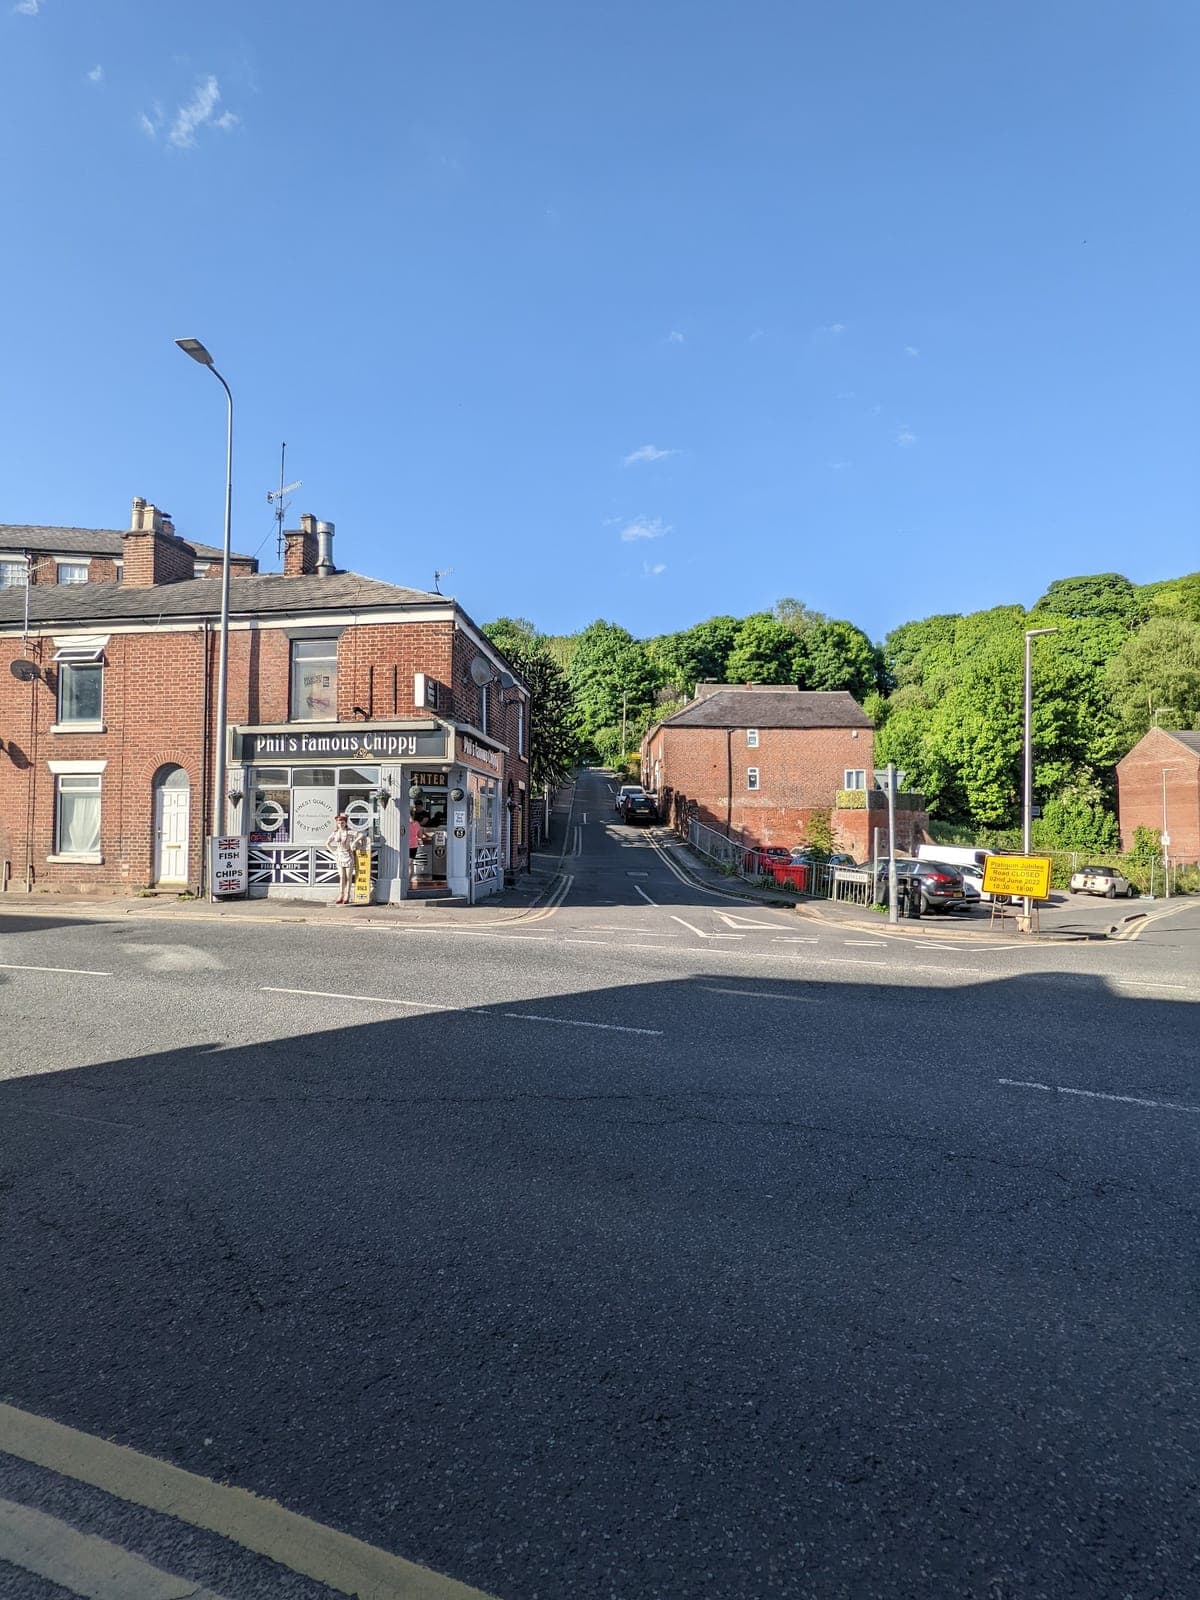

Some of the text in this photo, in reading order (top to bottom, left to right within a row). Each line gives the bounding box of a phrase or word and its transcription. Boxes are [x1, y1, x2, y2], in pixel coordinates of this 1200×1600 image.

[256, 732, 417, 755] Phil's Famous Chippy
[413, 773, 445, 785] ENTER
[296, 798, 333, 813] FINEST QUALITY
[311, 820, 332, 832] PRICES
[250, 834, 272, 842] OPEN
[218, 852, 240, 860] FISH
[216, 869, 243, 878] CHIPS
